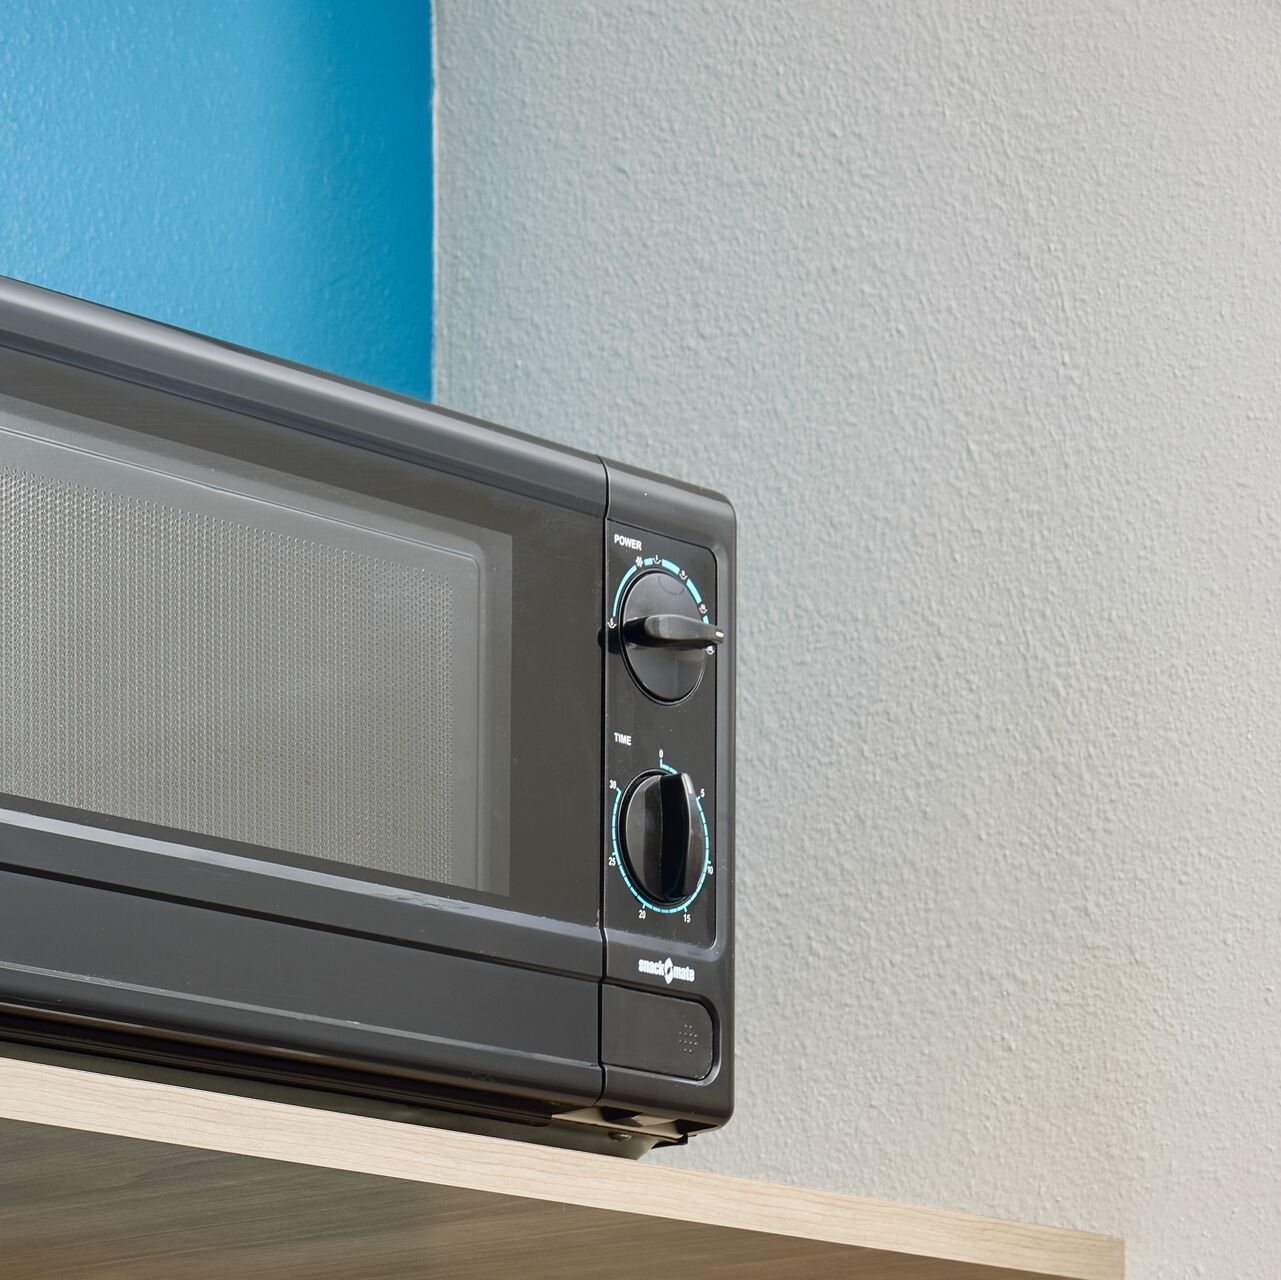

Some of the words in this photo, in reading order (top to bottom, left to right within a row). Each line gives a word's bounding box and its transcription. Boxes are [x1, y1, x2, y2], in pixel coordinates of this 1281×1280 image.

[614, 533, 642, 551] POWER
[614, 732, 632, 746] TIME
[658, 749, 664, 759] 0
[609, 779, 617, 790] 30
[700, 788, 705, 797] 5
[608, 857, 616, 867] 25
[707, 865, 714, 875] 10
[638, 909, 646, 920] 20
[683, 913, 691, 924] 15
